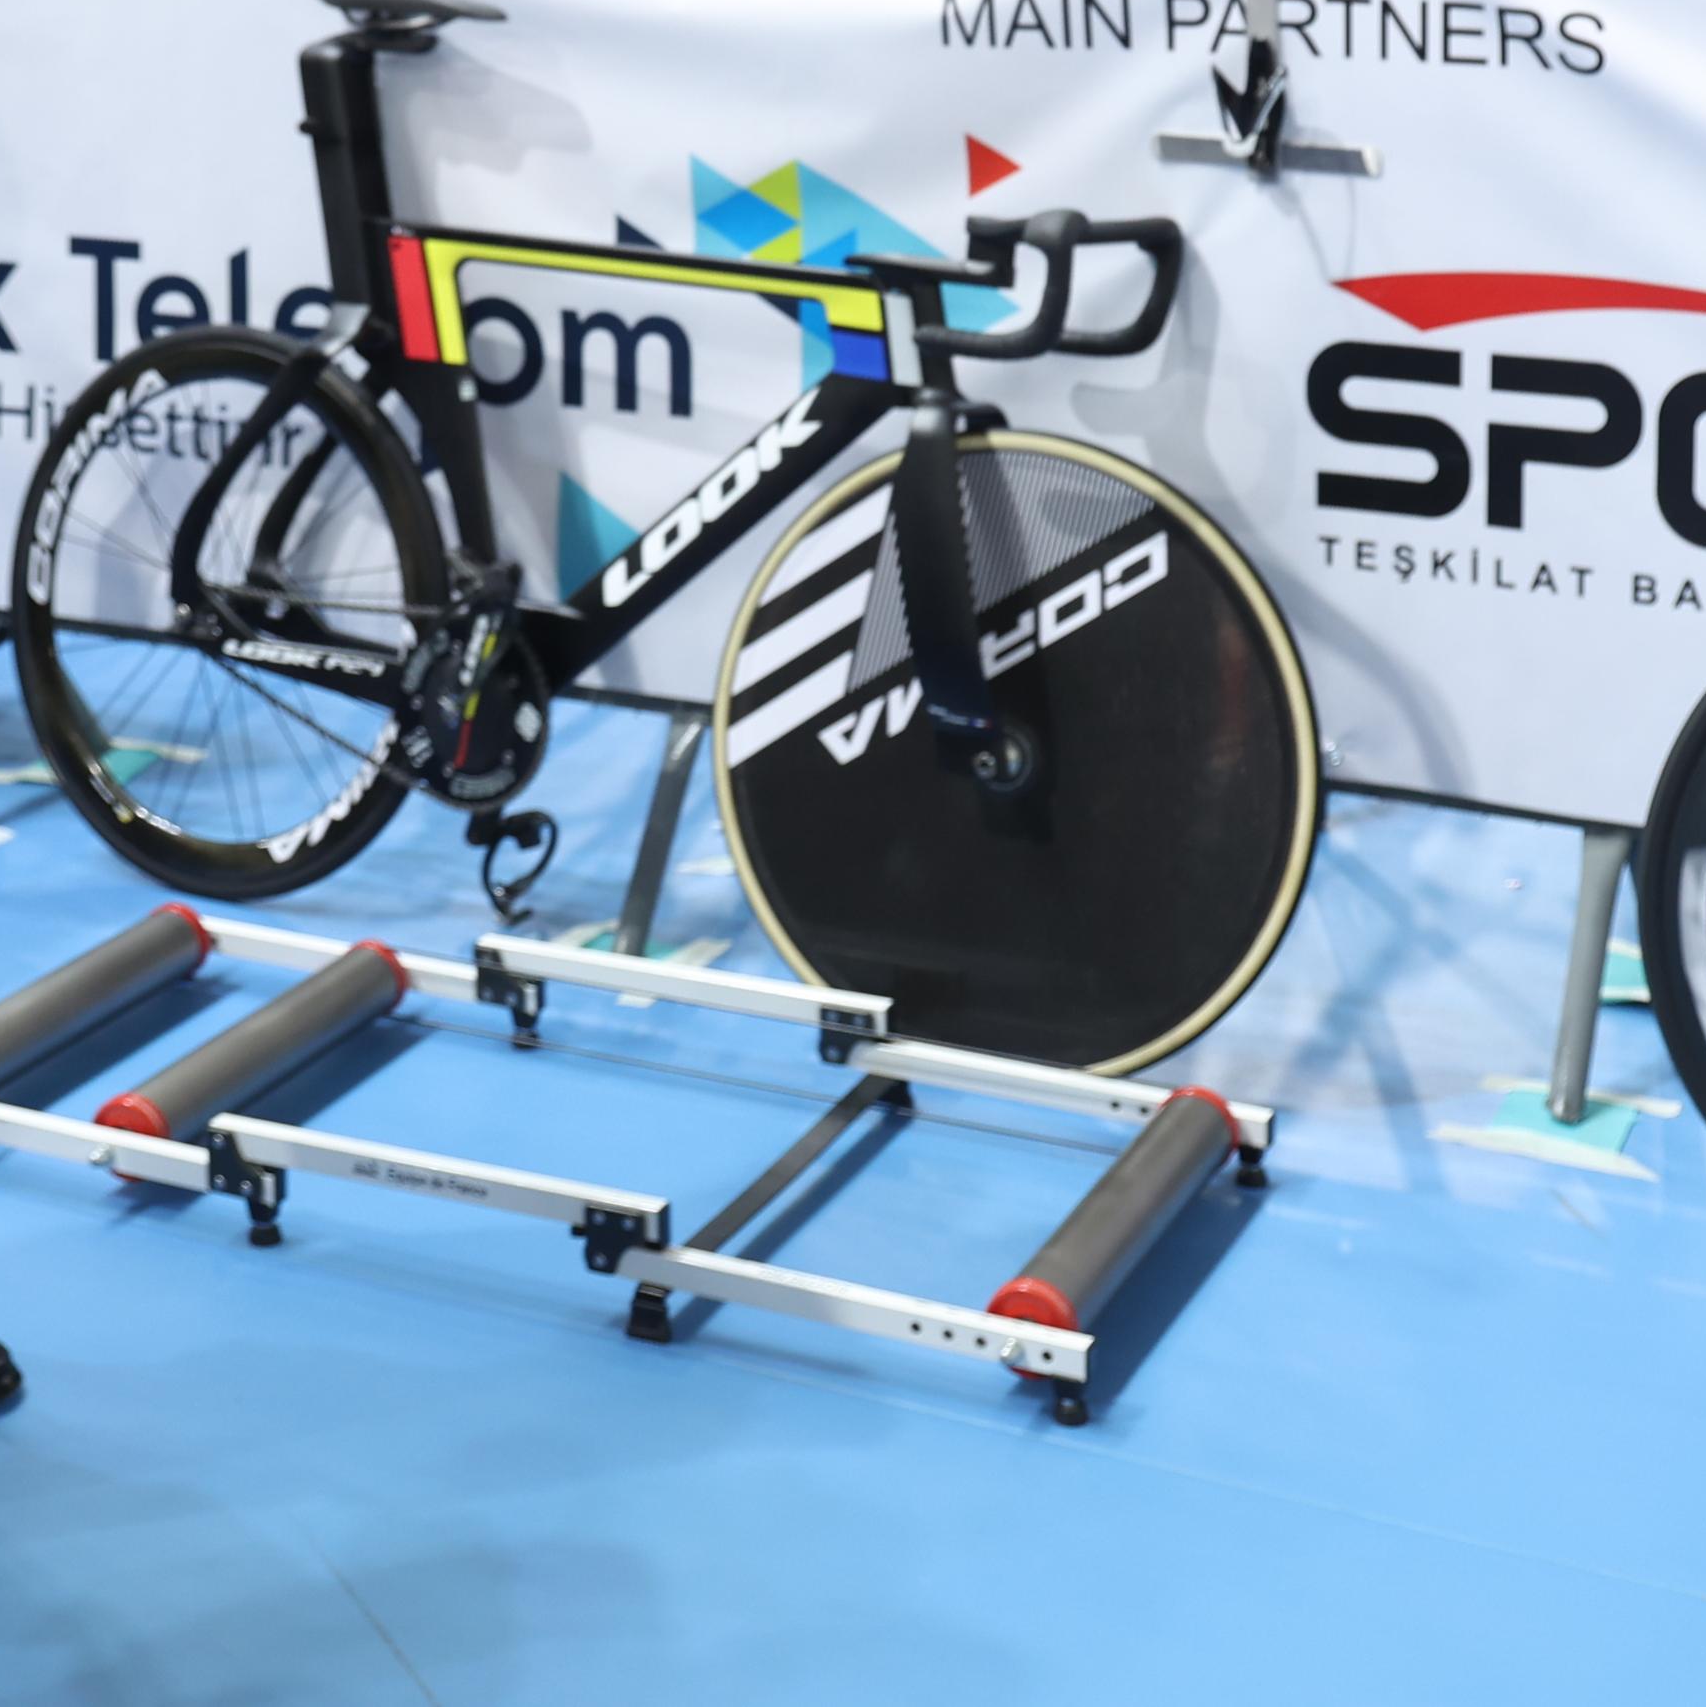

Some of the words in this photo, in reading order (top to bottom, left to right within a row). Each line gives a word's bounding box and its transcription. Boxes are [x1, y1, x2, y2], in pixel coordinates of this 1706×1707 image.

[70, 235, 692, 417] Teleom
[602, 388, 821, 607] LOOK
[1317, 536, 1595, 599] TEŞKİLAT
[819, 531, 1168, 766] CORMA
